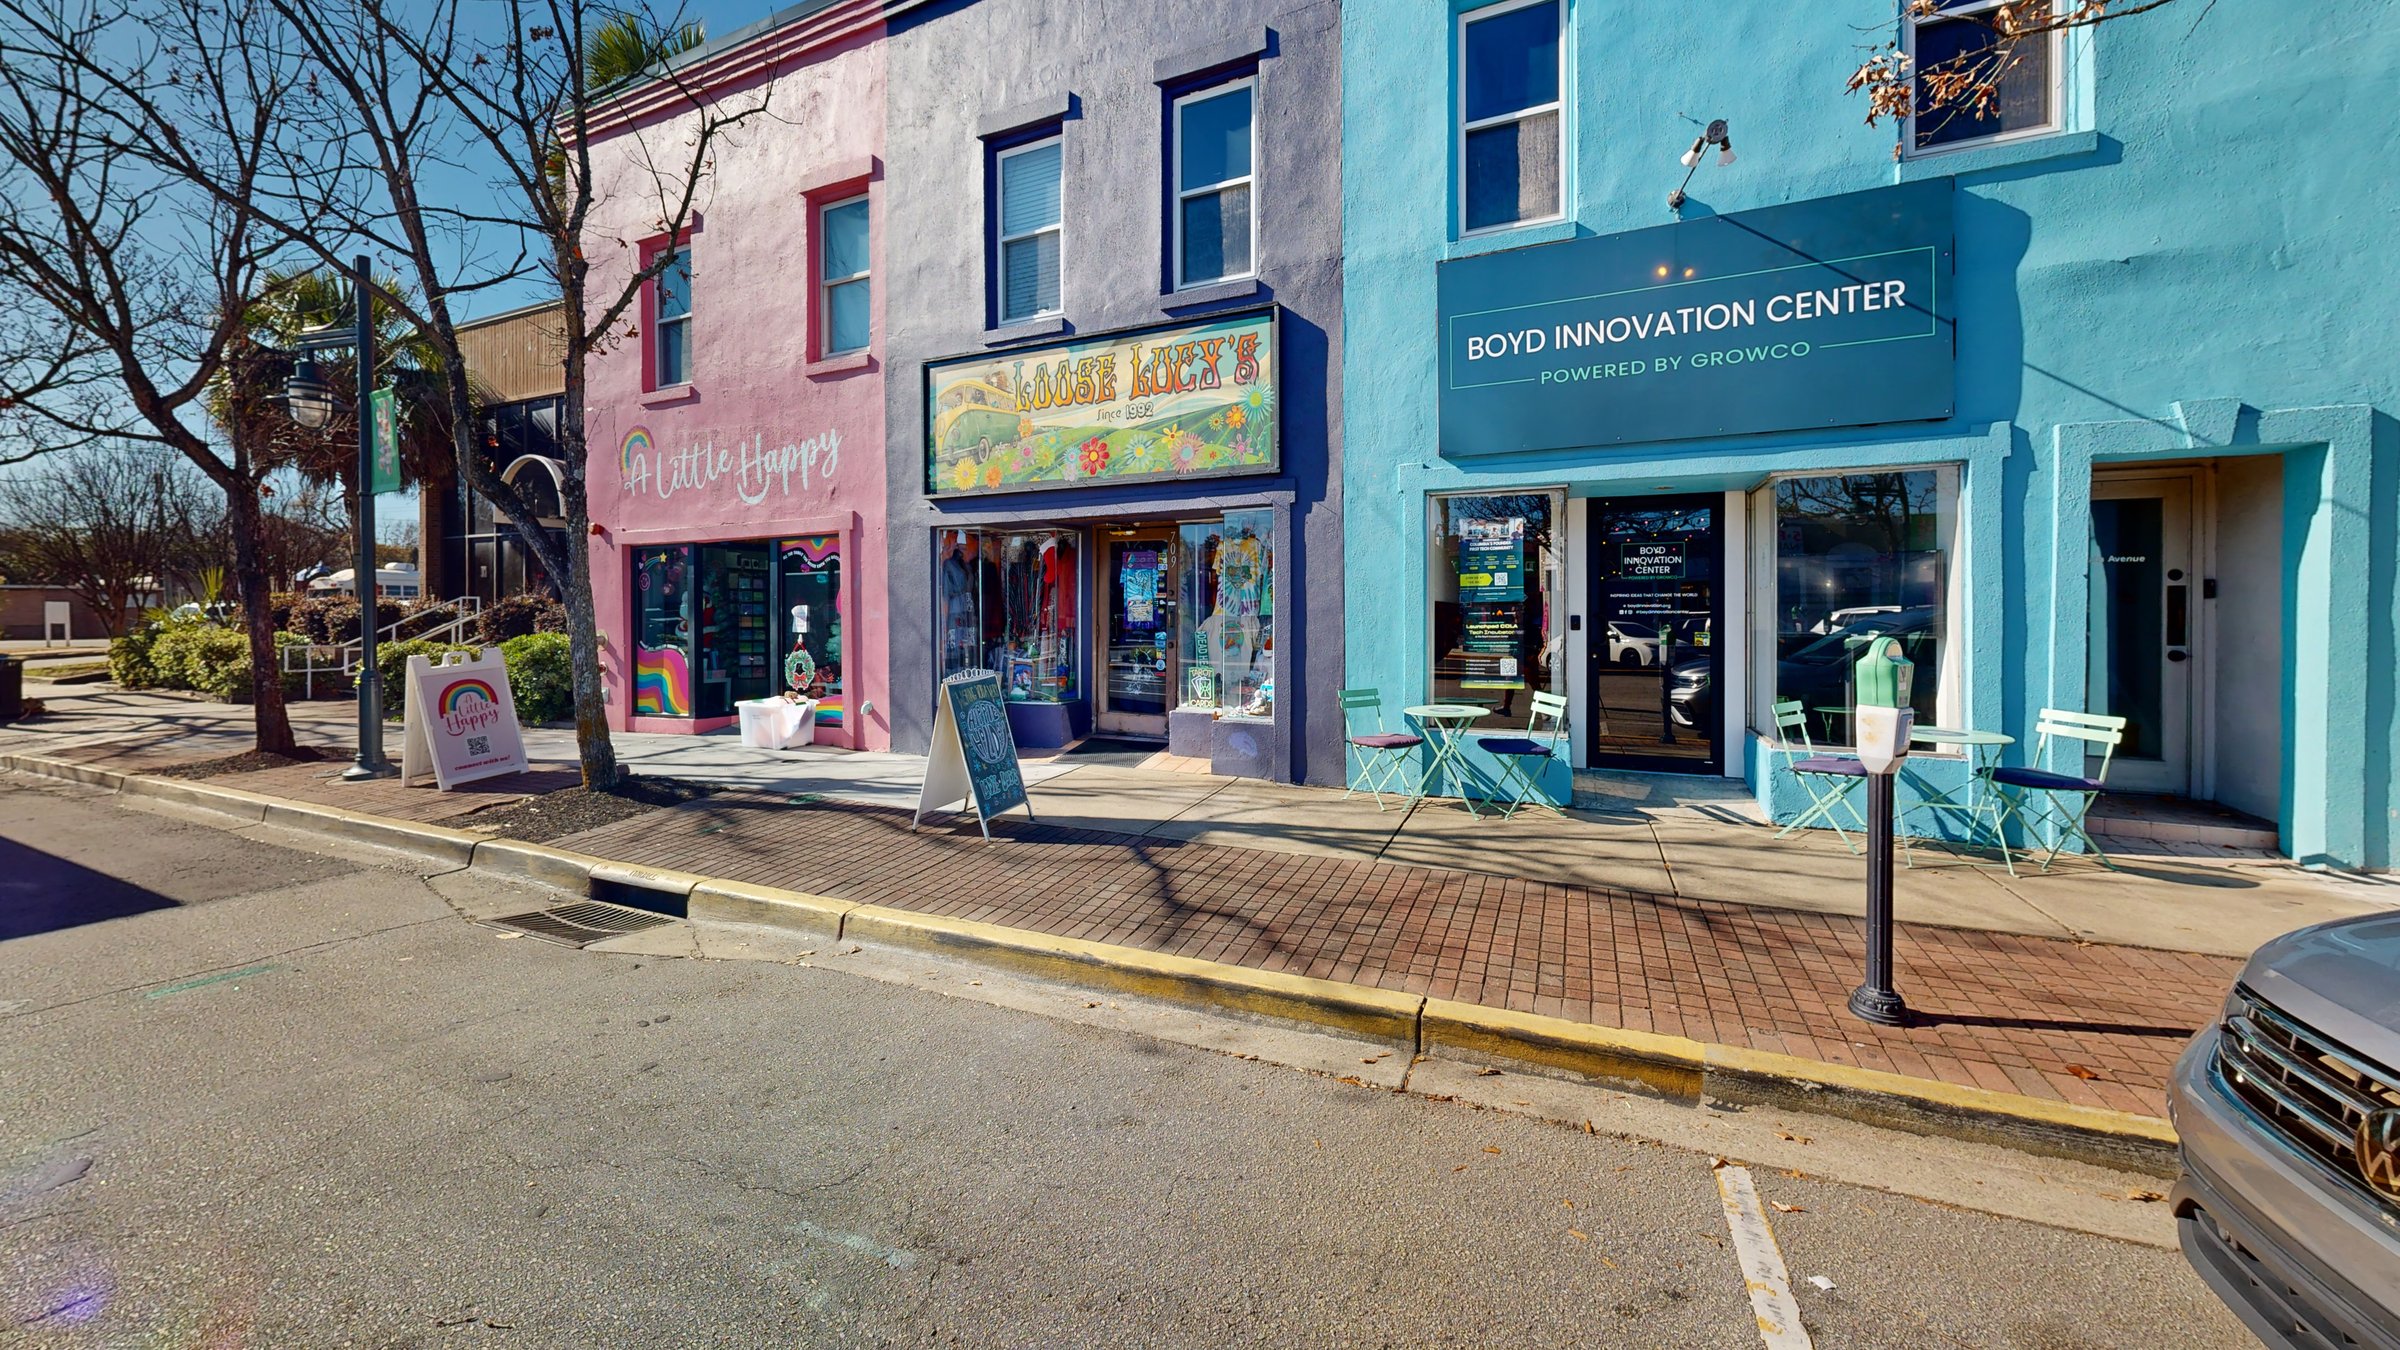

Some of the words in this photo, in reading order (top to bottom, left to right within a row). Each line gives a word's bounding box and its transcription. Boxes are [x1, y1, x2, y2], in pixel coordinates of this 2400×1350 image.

[1467, 328, 1546, 361] BOYD
[1555, 299, 1755, 349] INNOVATION
[1766, 279, 1906, 323] CENTER
[1014, 353, 1116, 413] LOOSE
[1129, 332, 1263, 402] LUCY'S
[1540, 360, 1646, 385] POWERED
[1654, 355, 1683, 372] BY
[1690, 341, 1811, 368] GROWCO
[1126, 401, 1153, 420] 1992
[624, 453, 651, 496] A
[736, 428, 842, 505] Happy
[1624, 556, 1682, 564] INNOVATION
[1635, 566, 1670, 574] CENTER
[1192, 668, 1212, 677] TAROT
[1190, 699, 1213, 707] CARDS
[446, 709, 498, 736] Happy
